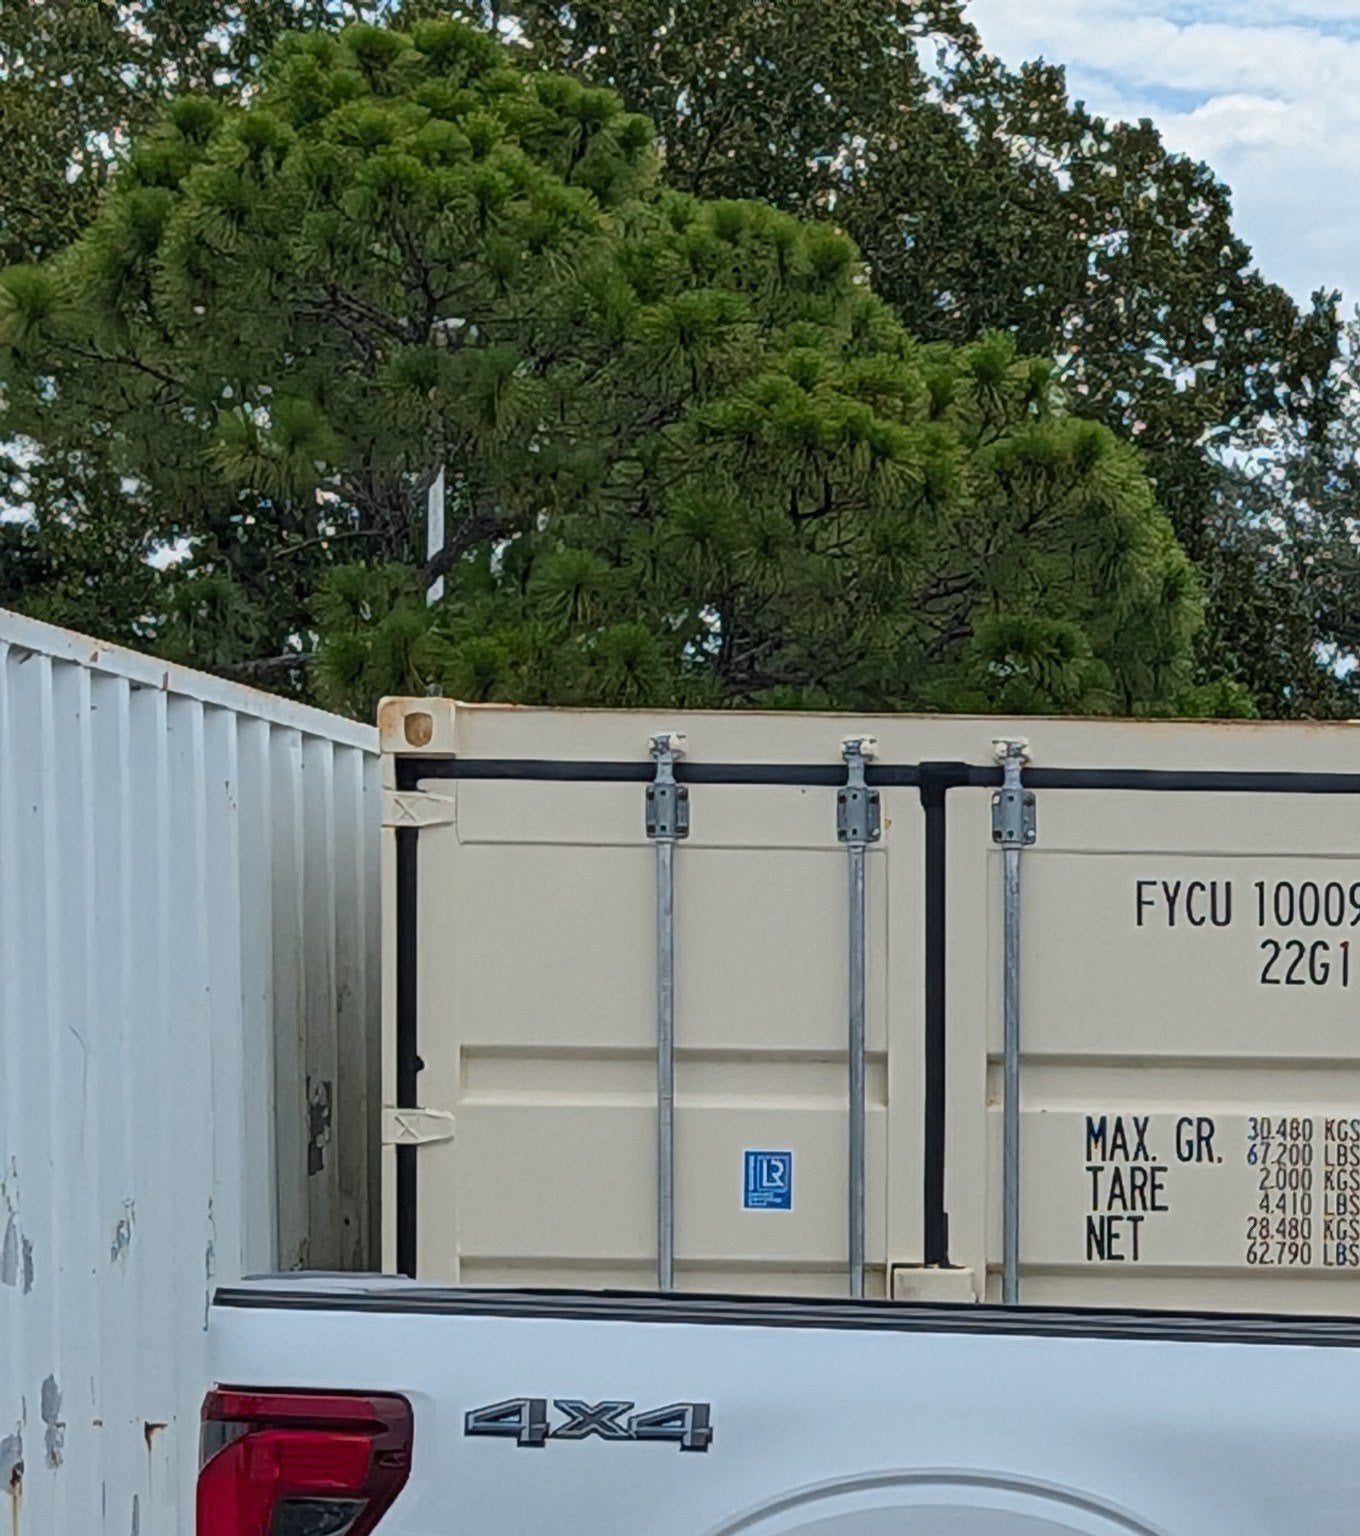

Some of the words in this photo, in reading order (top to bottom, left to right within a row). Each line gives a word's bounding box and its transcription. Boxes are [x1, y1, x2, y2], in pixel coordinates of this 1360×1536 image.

[1135, 880, 1233, 927] FYCU
[1260, 939, 1350, 987] 22G1
[1085, 1115, 1158, 1163] MAX.
[1176, 1116, 1223, 1164] GR.
[1247, 1117, 1313, 1142] 30.480
[1325, 1118, 1360, 1143] KGS
[1247, 1142, 1313, 1166] 67.200
[1324, 1143, 1360, 1167] LBS
[1085, 1165, 1169, 1212] TARE
[1324, 1168, 1360, 1191] KGS
[1259, 1193, 1312, 1215] 4.410
[1324, 1194, 1360, 1216] LBS
[1086, 1214, 1145, 1261] NET
[1247, 1217, 1312, 1240] 28.480
[1324, 1218, 1360, 1241] KGS
[1247, 1241, 1312, 1265] 62.790
[1323, 1242, 1360, 1266] LBS
